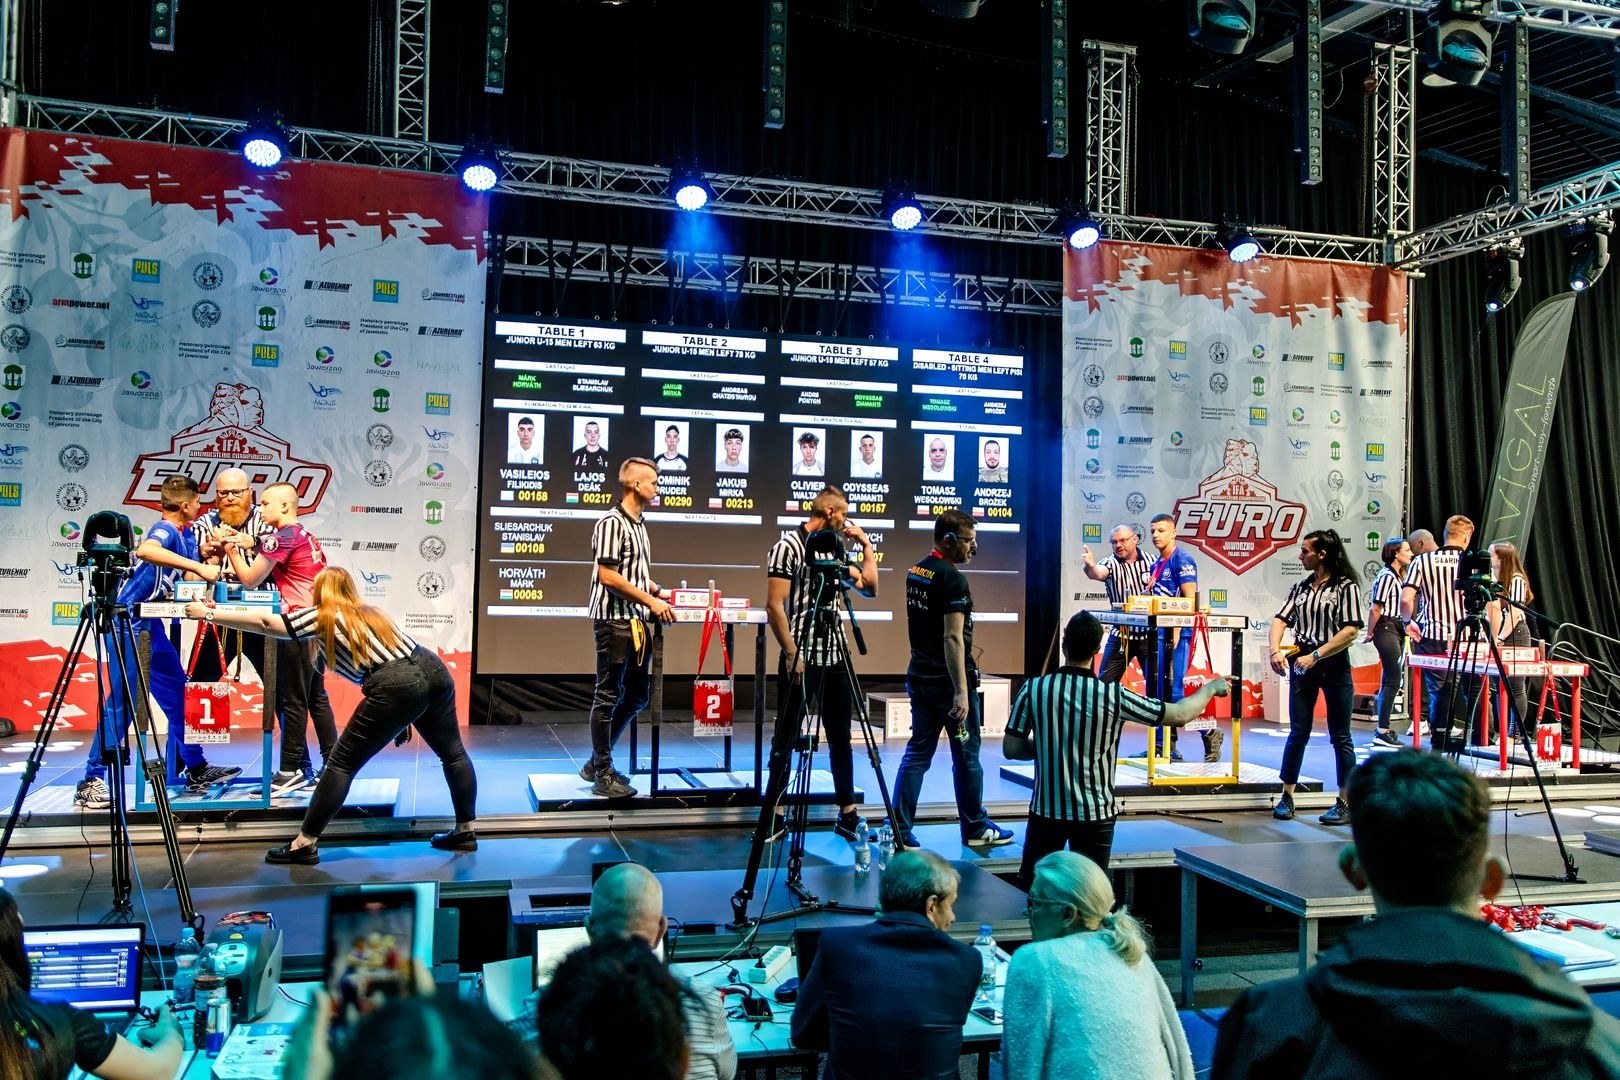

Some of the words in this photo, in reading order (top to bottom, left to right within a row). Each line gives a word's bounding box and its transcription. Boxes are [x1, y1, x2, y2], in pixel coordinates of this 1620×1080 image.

[135, 260, 158, 275] PULS
[375, 282, 396, 296] PULS
[52, 298, 110, 310] armpower.net
[538, 326, 575, 337] TABLE
[580, 329, 585, 338] 1
[506, 336, 536, 345] JUNIOR
[555, 339, 573, 348] MEN
[574, 340, 593, 348] LEFT
[604, 342, 616, 350] KG
[683, 336, 718, 347] TABLE
[722, 339, 728, 347] 2
[255, 346, 277, 360] PULS
[652, 346, 681, 354] JUNIOR
[698, 348, 715, 356] MEN
[716, 349, 734, 358] LEFT
[745, 351, 756, 359] KG
[819, 345, 853, 355] TABLE
[791, 355, 817, 363] JUNIOR
[834, 357, 850, 365] MEN
[851, 358, 868, 366] LEFT
[949, 354, 980, 363] TABLE
[983, 356, 989, 364] 4
[913, 362, 947, 371] DISABLED
[951, 364, 977, 372] SITTING
[978, 366, 992, 374] MEN
[993, 367, 1010, 375] LEFT
[428, 395, 449, 408] PULS
[223, 440, 240, 452] IFA
[500, 469, 550, 480] VASILEIOS
[574, 472, 606, 483] LAJOS
[507, 480, 542, 490] FILIKIDIS
[658, 475, 690, 486] OMINIK
[716, 478, 748, 488] JAKUB
[791, 481, 826, 490] OLIVIER
[578, 483, 601, 492] DEÁK
[719, 489, 744, 497] MIRKA
[843, 483, 889, 493] ODYSSEAS
[921, 485, 956, 496] TOMASZ
[974, 488, 1012, 498] ANDRZEJ
[1233, 485, 1244, 495] IFA
[583, 494, 612, 504] 00217
[793, 492, 820, 500] WALTA
[849, 494, 883, 502] DIAMANTI
[664, 497, 692, 507] 00290
[726, 499, 753, 509] 00213
[979, 498, 1007, 507] BROŻEK
[351, 504, 403, 514] armpower.net
[988, 508, 1012, 517] 00104
[1177, 503, 1304, 539] EURO
[494, 522, 553, 533] SLIESARCHUK
[502, 533, 545, 542] STANISLAV
[51, 541, 83, 549] Jaworz
[515, 542, 545, 553] 00108
[858, 553, 884, 562] 007
[499, 567, 546, 579] HORVÁTH
[510, 578, 534, 588] MÁRK
[514, 590, 543, 600] 00063
[55, 604, 79, 617] PULS
[200, 699, 214, 724] 1
[707, 695, 720, 718] 2
[1544, 736, 1554, 755] 4
